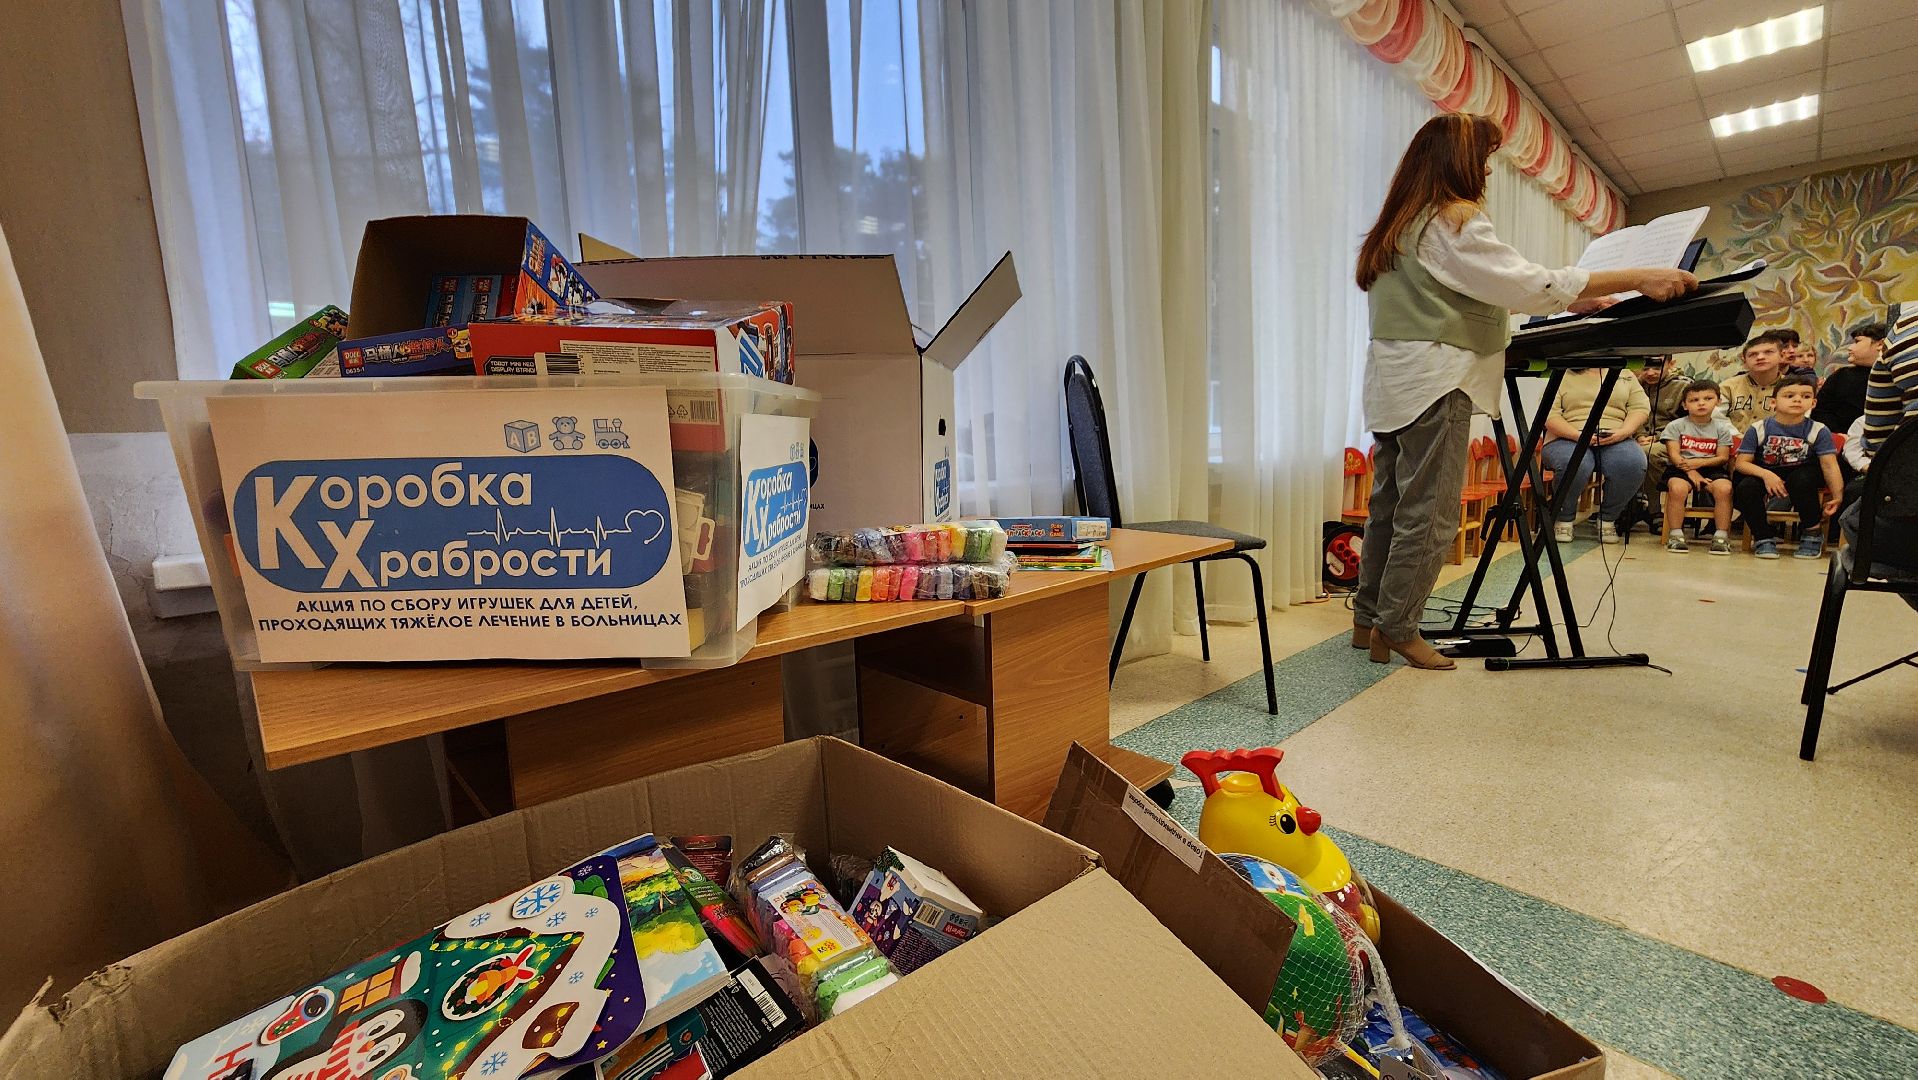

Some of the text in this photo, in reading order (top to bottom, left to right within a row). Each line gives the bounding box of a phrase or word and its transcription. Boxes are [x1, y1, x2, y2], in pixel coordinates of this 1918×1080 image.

[254, 462, 532, 570] Коробка
[745, 467, 793, 545] Коробка
[756, 504, 801, 552] Храбрости
[317, 519, 612, 589] Храбрости
[258, 612, 682, 632] ПРОХОДЯЩИХ ТЯЖЁЛОЕ ЛЕЧЕНИЕ В БОЛЬНИЦАХ
[296, 593, 638, 613] АКЦИЯ ПО СБОРУ ИГРУШЕК ДЛЯ ДЕТЕЙ,
